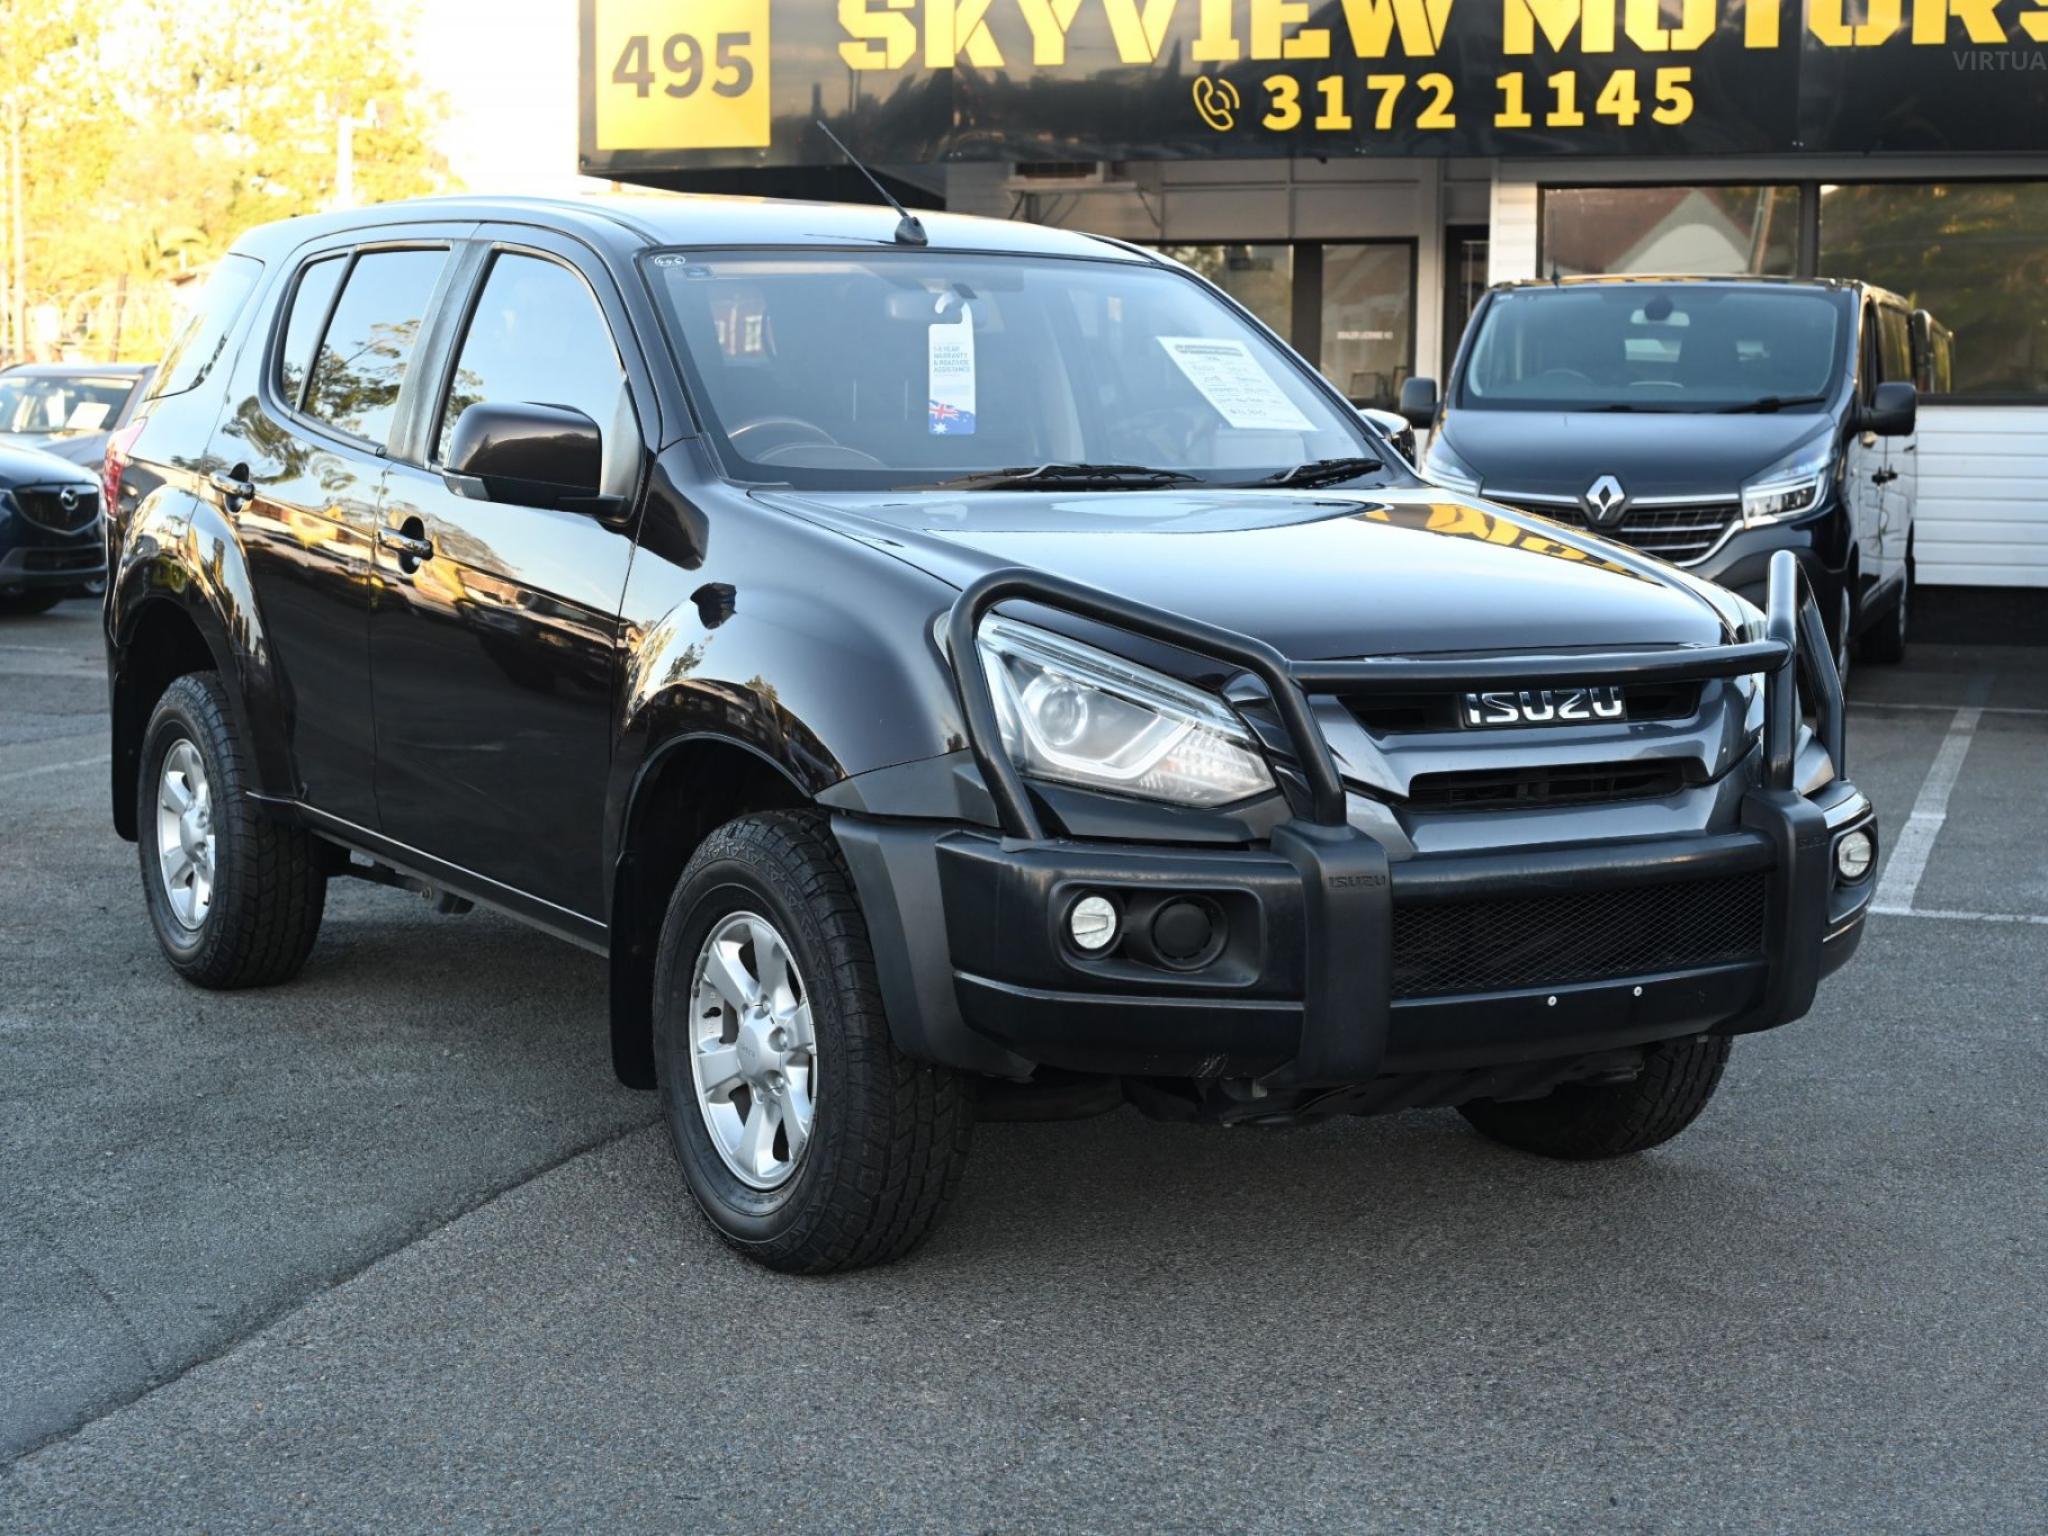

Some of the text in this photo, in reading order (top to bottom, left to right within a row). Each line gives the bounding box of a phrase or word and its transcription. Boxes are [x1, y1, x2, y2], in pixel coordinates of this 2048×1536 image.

[612, 31, 753, 99] 495
[838, 0, 2048, 70] SKYVIEW MOTOR
[1261, 66, 1694, 131] 3172 1145
[1465, 686, 1623, 725] ISUZU
[1328, 874, 1386, 888] ISUZU
